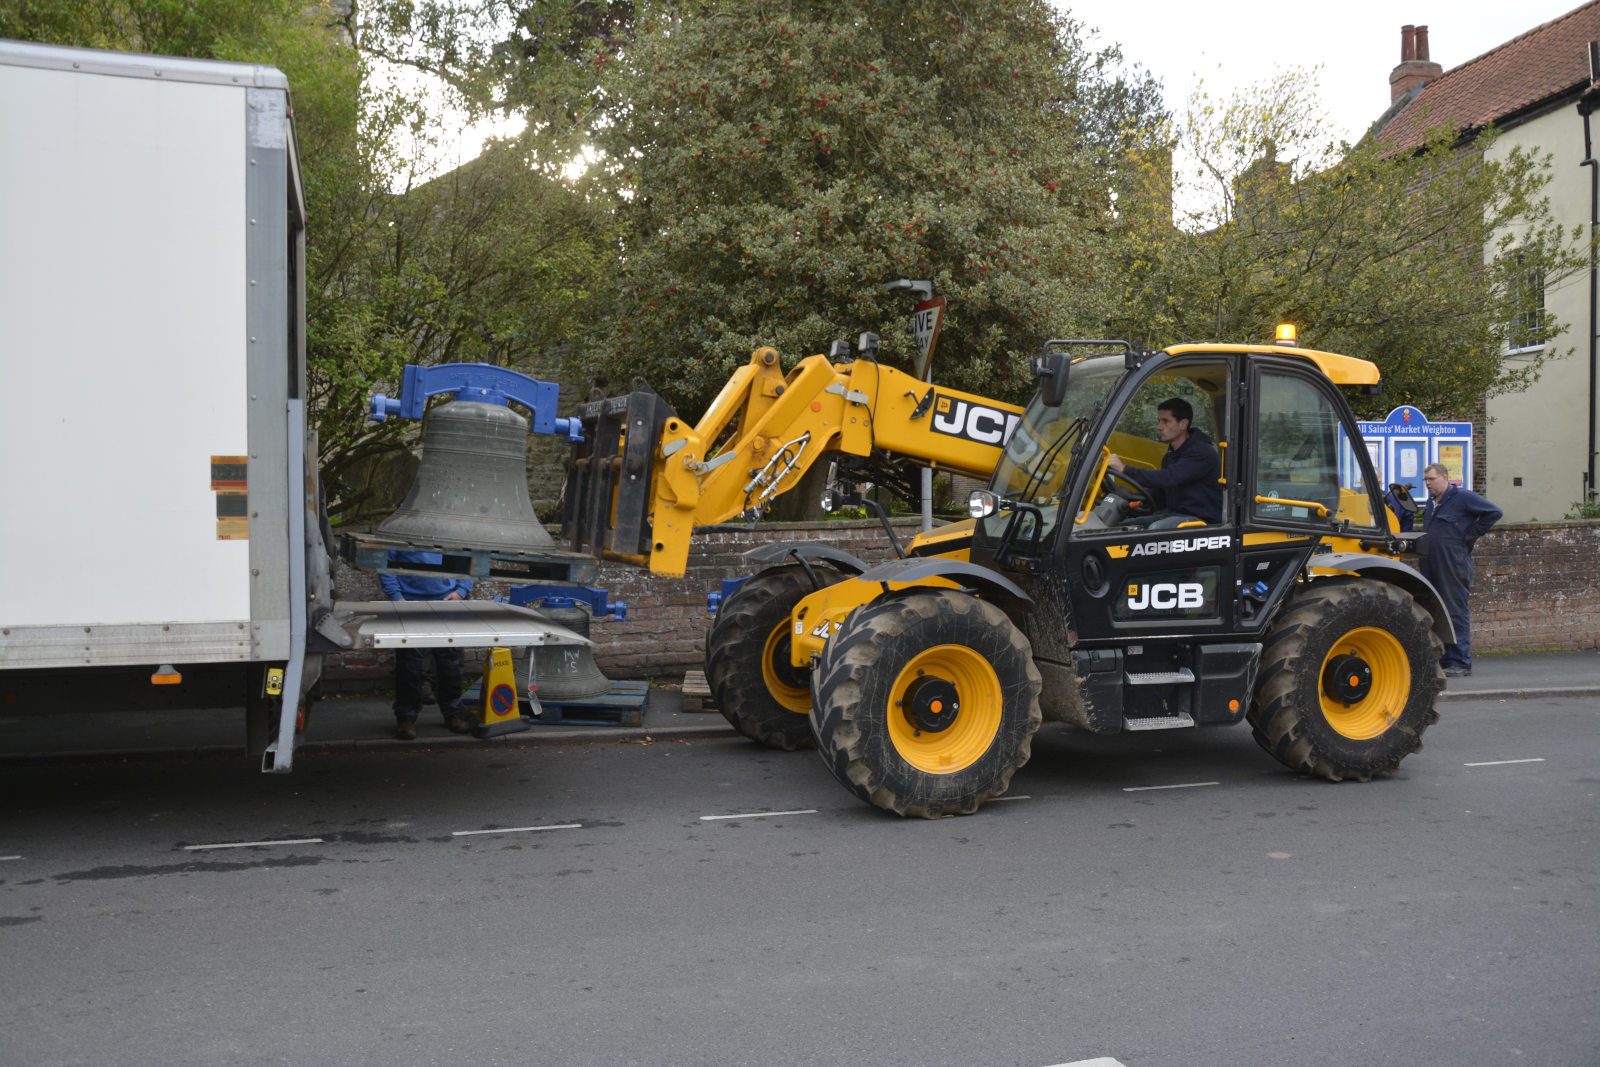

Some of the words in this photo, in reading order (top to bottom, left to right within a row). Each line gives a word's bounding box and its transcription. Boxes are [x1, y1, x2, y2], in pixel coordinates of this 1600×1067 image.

[1394, 425, 1421, 434] Market
[1422, 425, 1456, 436] Weighton
[1131, 535, 1231, 557] AGRISUPER
[1128, 582, 1204, 610] JCB
